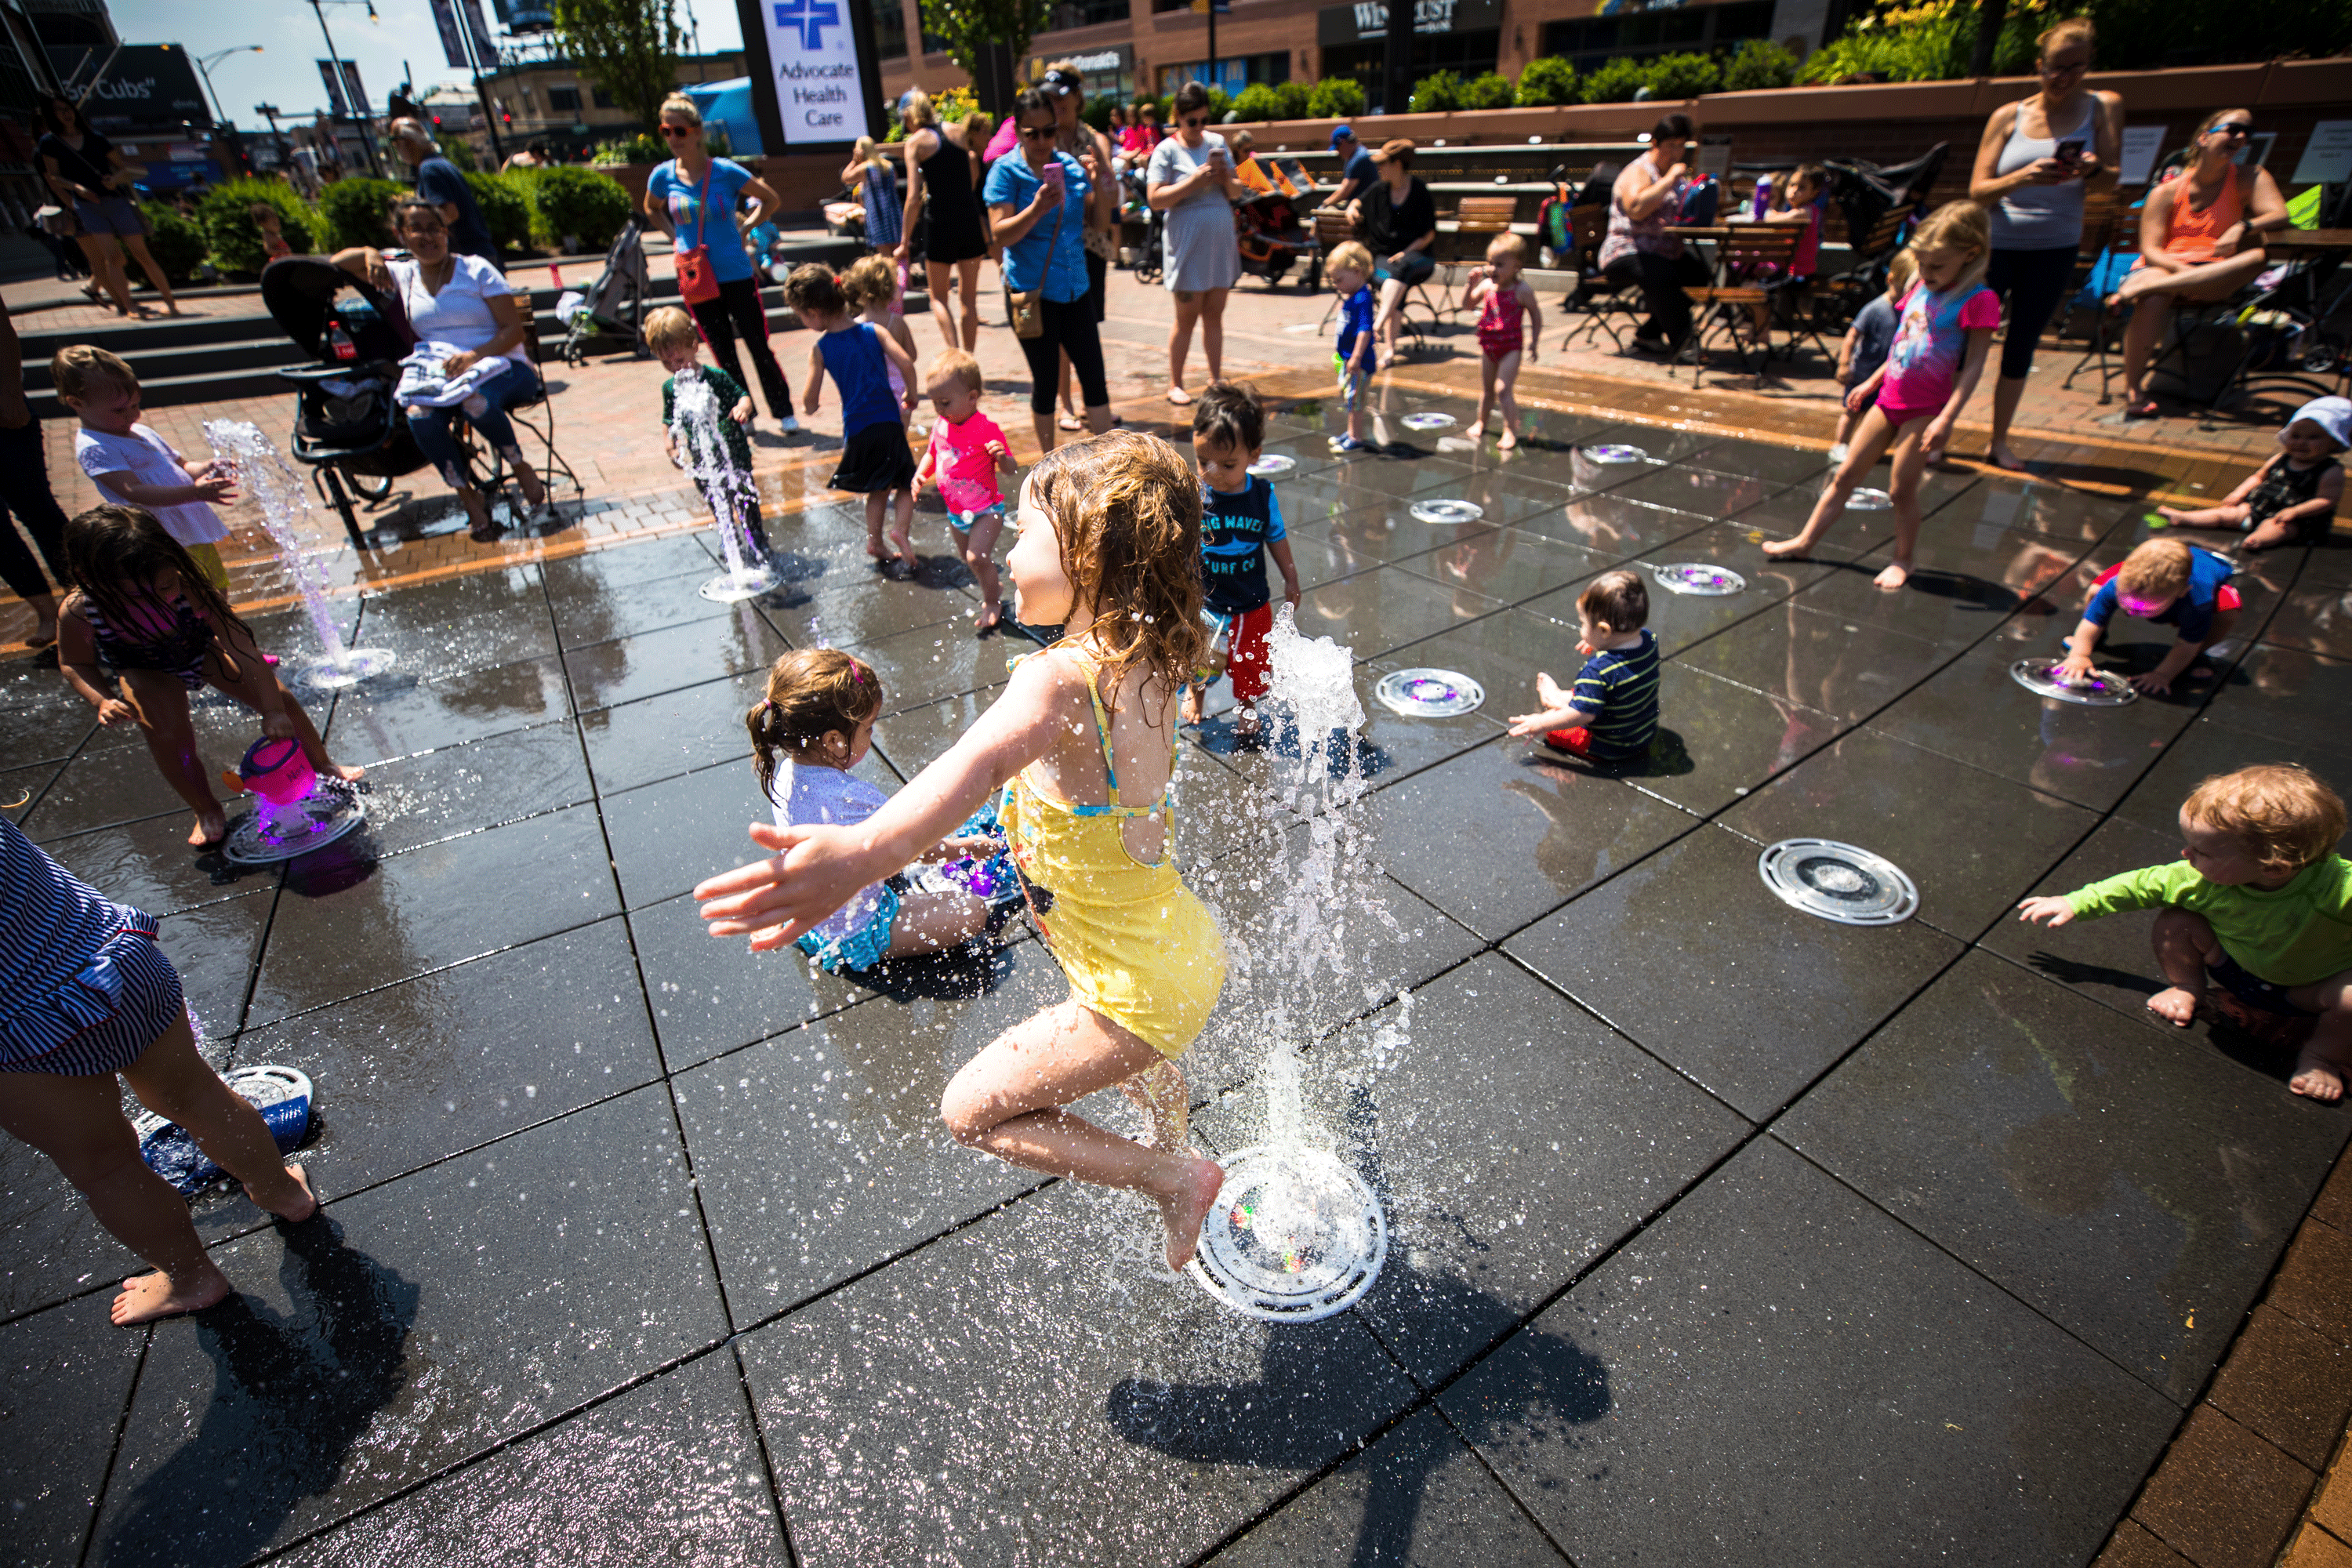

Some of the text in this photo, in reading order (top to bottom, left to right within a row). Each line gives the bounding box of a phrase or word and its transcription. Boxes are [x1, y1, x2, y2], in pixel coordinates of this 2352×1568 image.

[779, 61, 854, 79] Advocate
[793, 84, 848, 103] Health
[805, 109, 843, 126] Care
